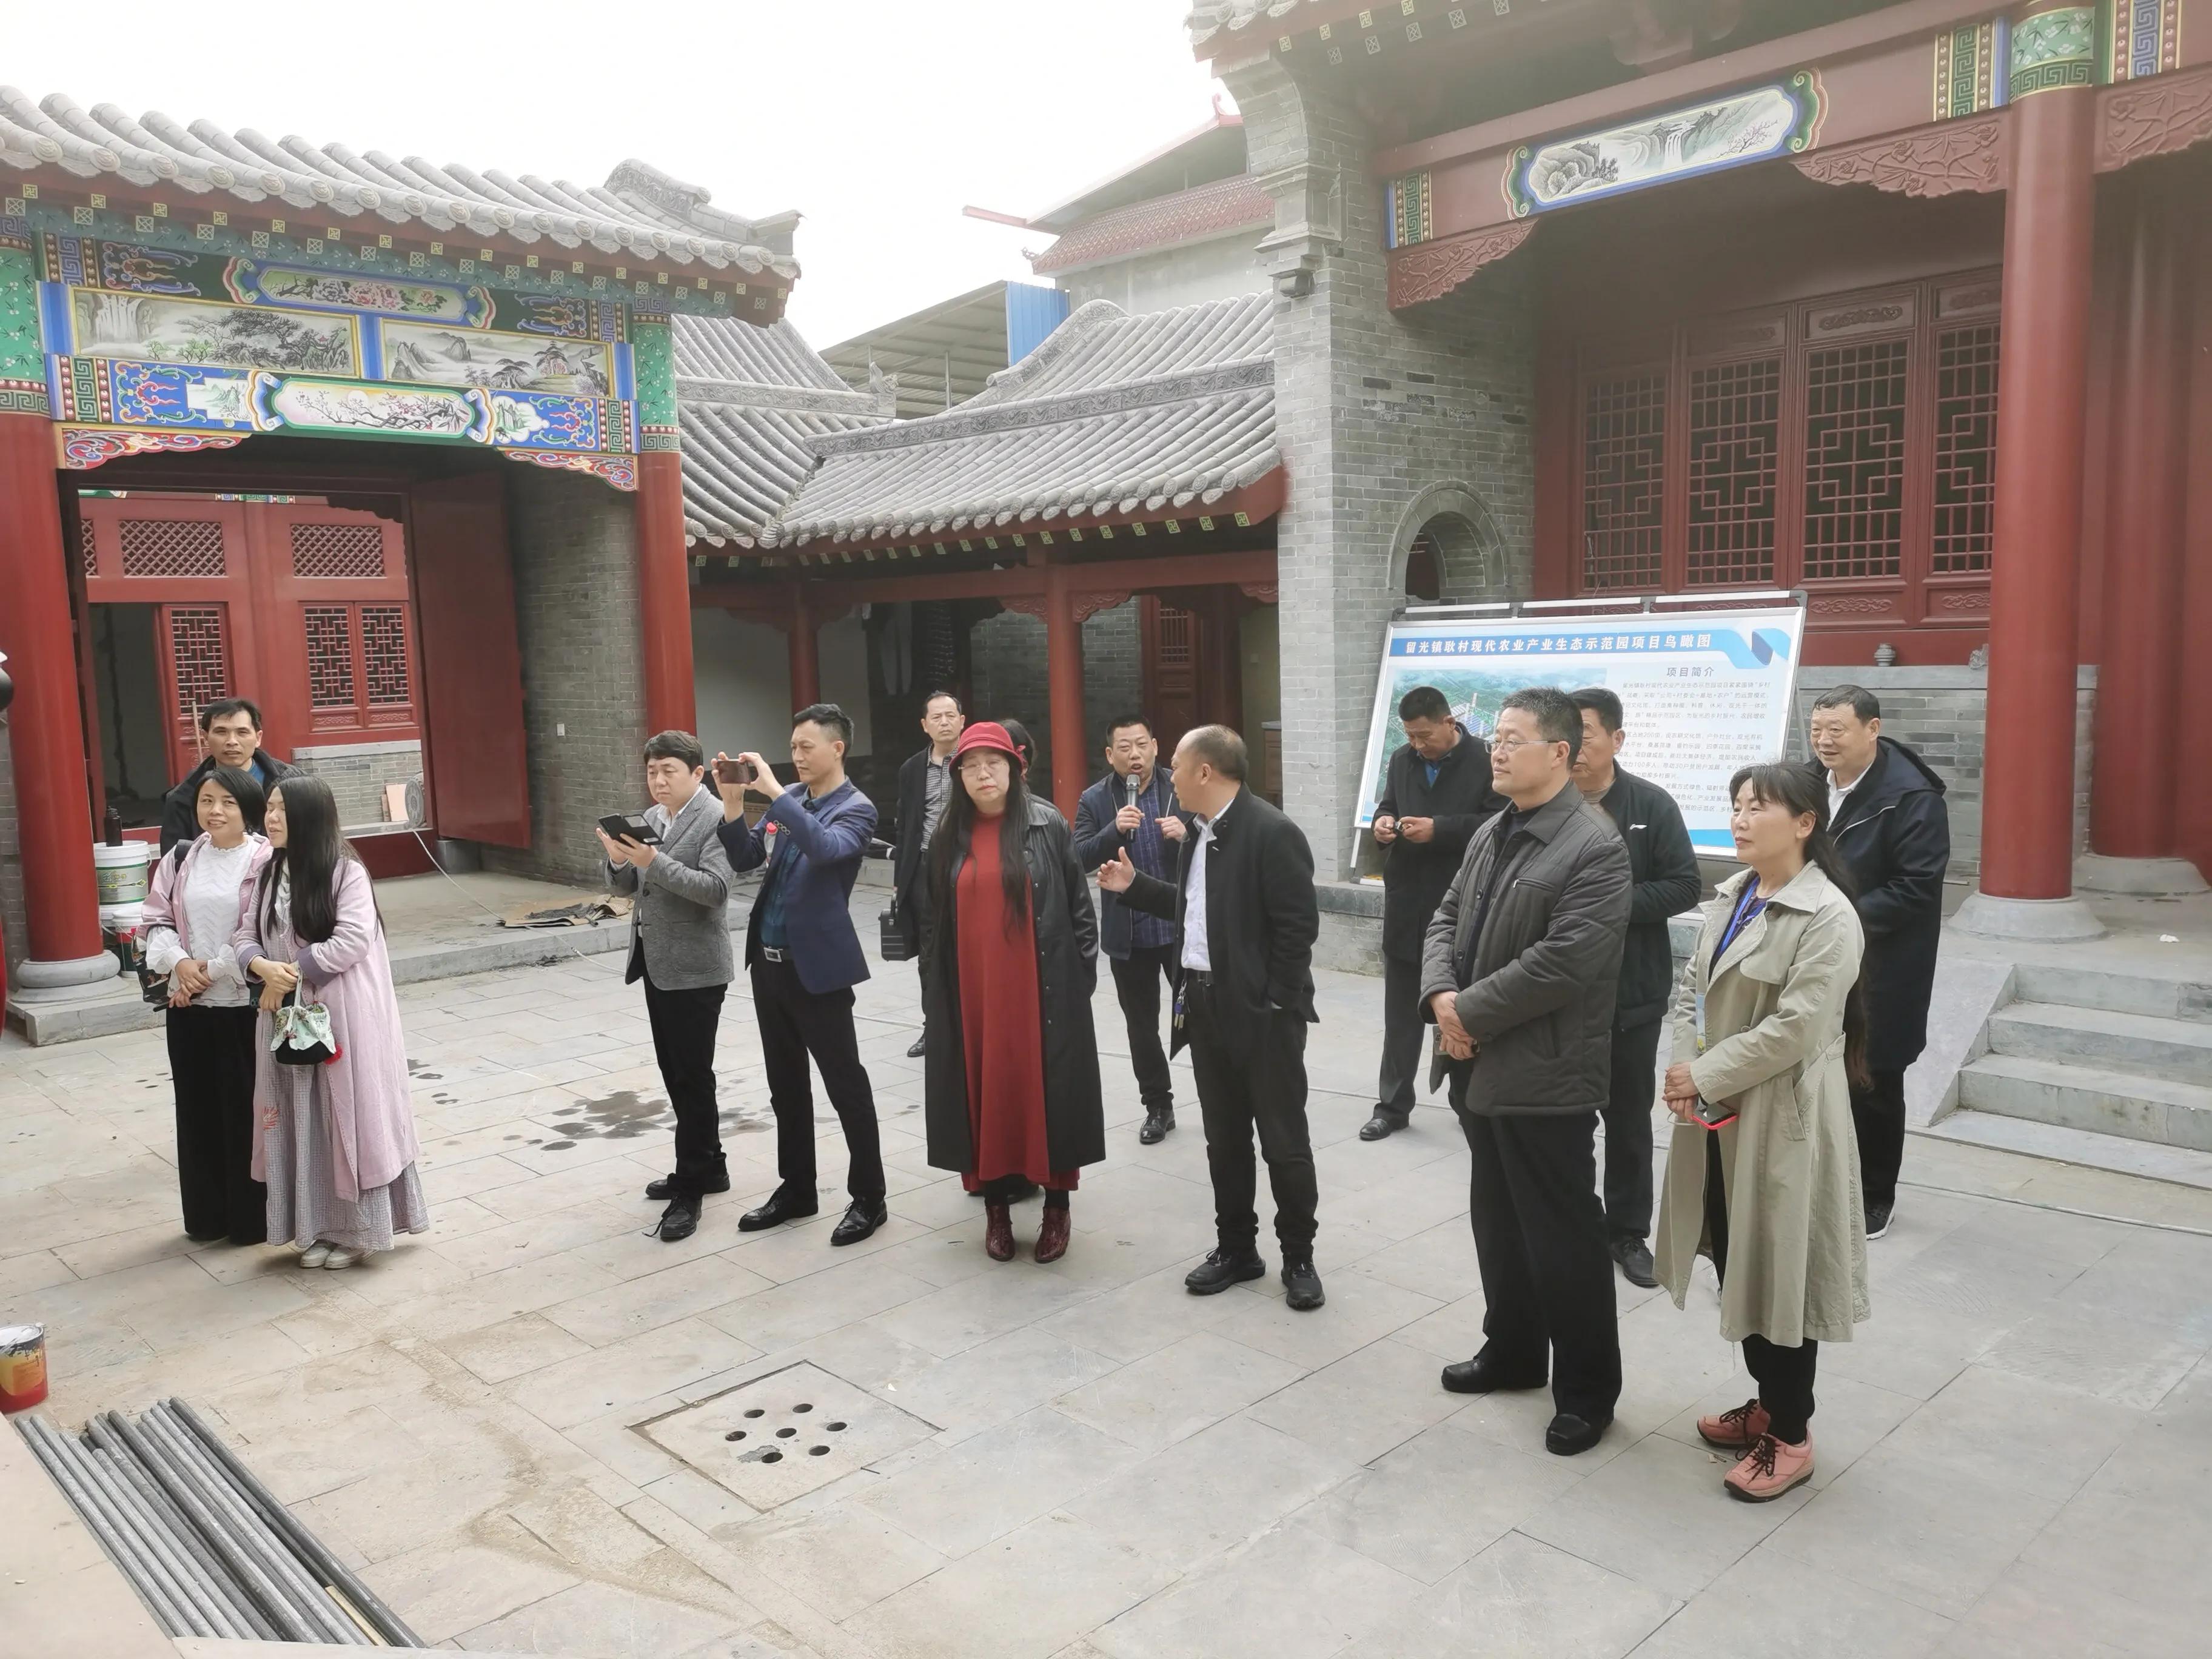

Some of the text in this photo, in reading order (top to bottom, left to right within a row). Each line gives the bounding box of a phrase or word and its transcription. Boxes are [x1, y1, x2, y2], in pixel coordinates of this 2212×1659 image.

[1406, 634, 1712, 654] 留光镇耿村现代农业产业生态示范园项目鸟瞰图
[1666, 666, 1715, 677] 项目简介
